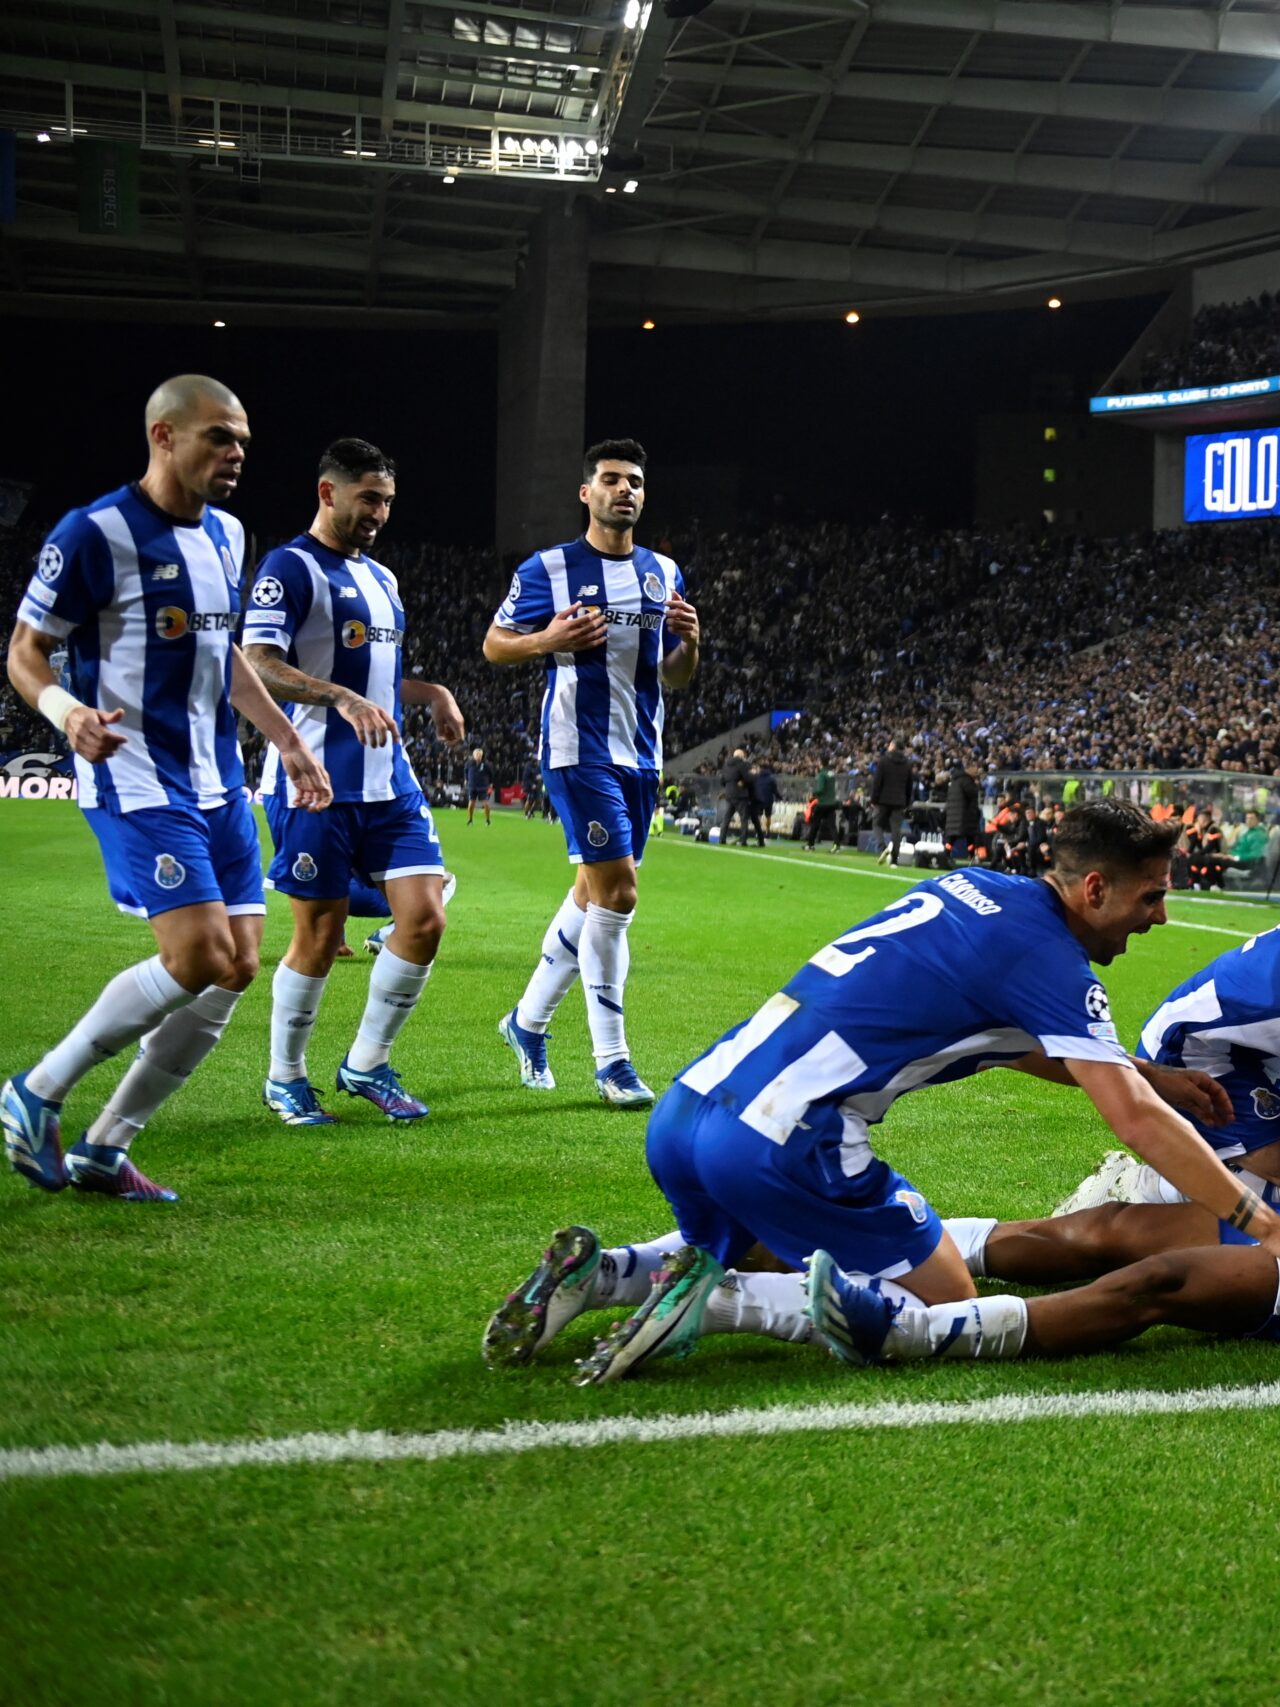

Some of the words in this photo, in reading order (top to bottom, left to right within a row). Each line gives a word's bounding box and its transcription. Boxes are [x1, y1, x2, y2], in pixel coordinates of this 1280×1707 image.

[103, 168, 117, 229] RESPECT
[1106, 394, 1167, 409] FUTEBOL
[1168, 389, 1209, 403] CLUBE
[1210, 386, 1228, 398] DO
[1229, 380, 1270, 395] PORTO
[1204, 435, 1279, 512] GOLO
[0, 776, 78, 800] MOR
[808, 891, 945, 977] 2
